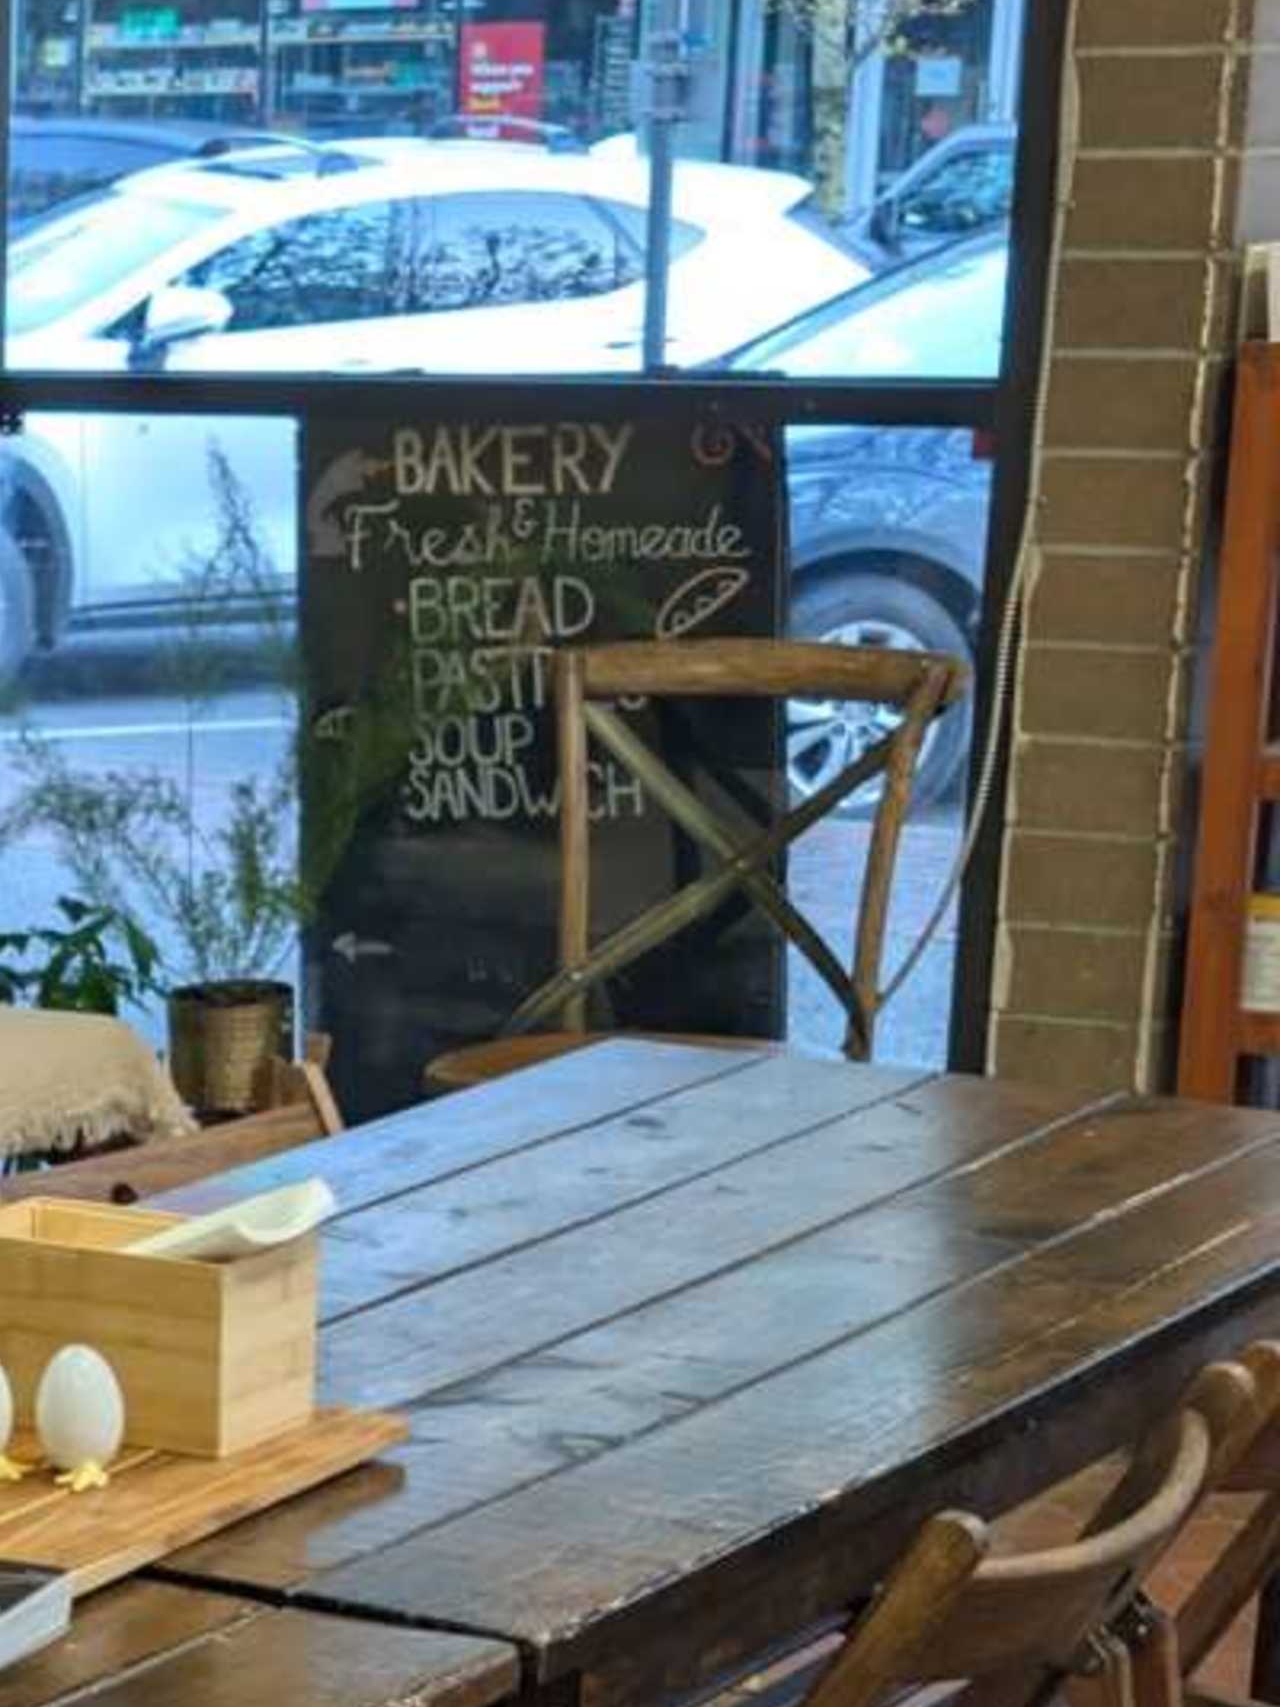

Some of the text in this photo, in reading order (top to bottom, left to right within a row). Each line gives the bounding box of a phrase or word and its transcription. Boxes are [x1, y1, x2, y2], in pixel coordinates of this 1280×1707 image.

[394, 423, 634, 495] BAKERY
[344, 498, 750, 567] Fresh & Homeade
[409, 574, 594, 644] BREAD
[408, 714, 535, 768] SOUP
[404, 764, 643, 821] SANDWCH
